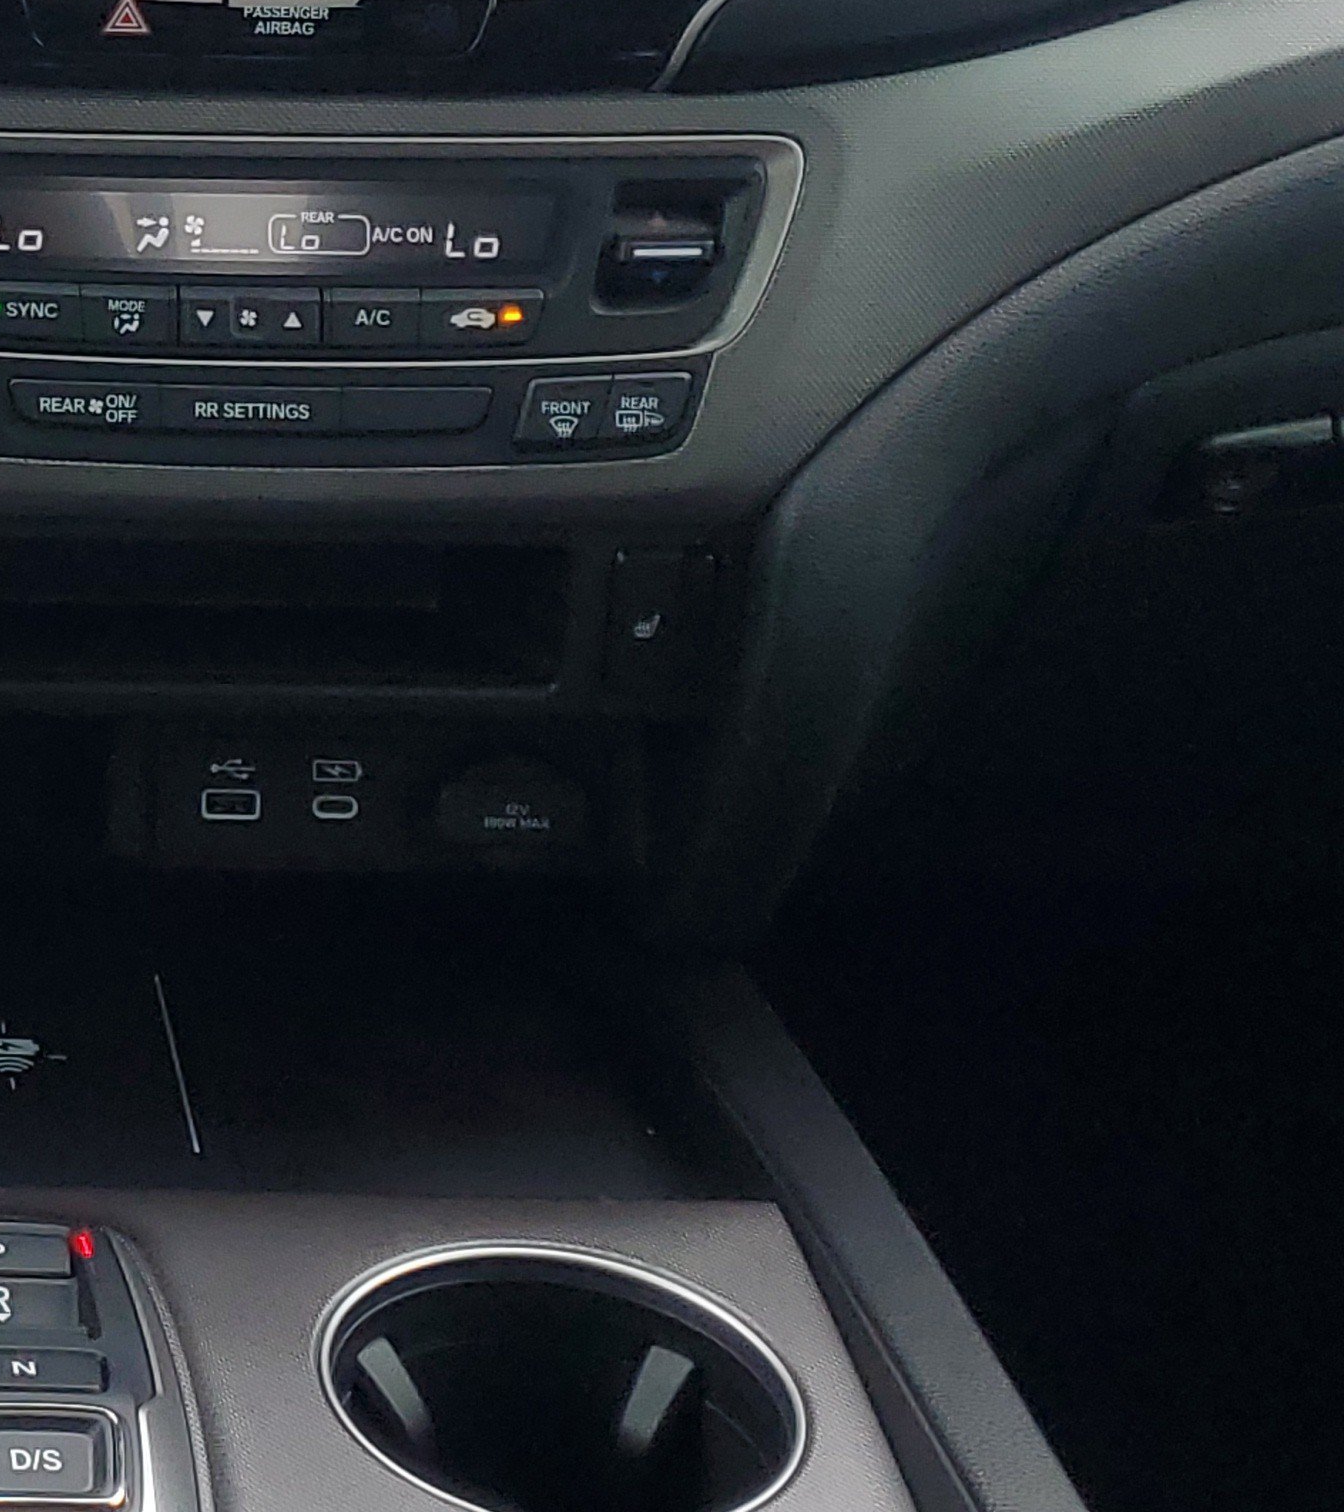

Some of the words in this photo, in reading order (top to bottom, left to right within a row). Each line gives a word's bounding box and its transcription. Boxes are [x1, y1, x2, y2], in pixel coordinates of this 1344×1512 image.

[243, 5, 330, 21] PASSENGER
[254, 21, 315, 36] AIRBAG
[300, 211, 335, 224] REAR
[371, 227, 403, 243] A/C
[406, 227, 434, 244] ON
[445, 220, 500, 258] Lo
[5, 301, 59, 319] SYNC
[108, 299, 146, 313] MODE
[355, 309, 391, 326] A/C
[39, 396, 85, 413] REAR
[105, 393, 137, 409] ON/
[194, 402, 220, 418] RR
[222, 402, 311, 420] SETTINGS
[541, 400, 592, 416] FRONT
[620, 396, 659, 411] REAR
[105, 408, 138, 424] OFF
[11, 1360, 38, 1376] N
[9, 1447, 64, 1472] D/S
